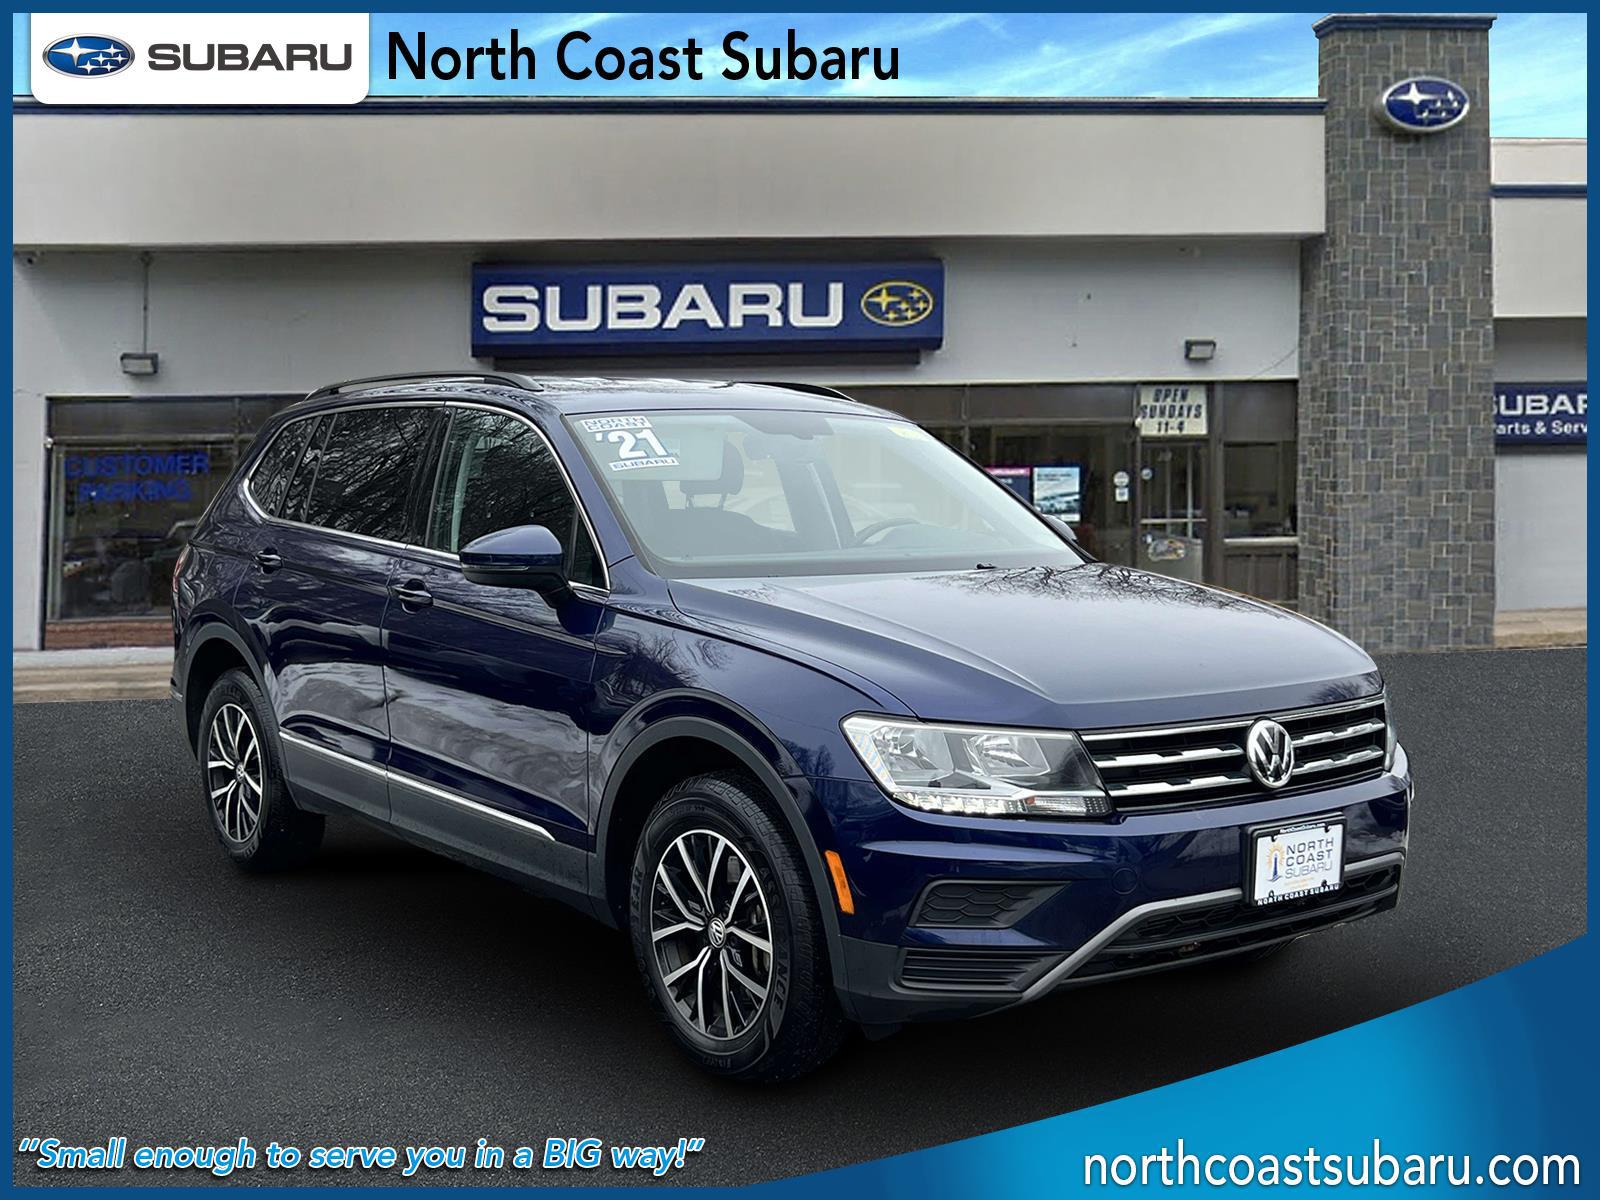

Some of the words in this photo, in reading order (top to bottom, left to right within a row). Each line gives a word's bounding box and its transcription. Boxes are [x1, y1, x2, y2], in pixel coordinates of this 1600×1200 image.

[482, 282, 844, 332] SUBARU
[1153, 388, 1189, 403] OPEN
[1493, 394, 1587, 416] UBA
[584, 416, 646, 427] NORTH
[1140, 404, 1202, 419] SUNDAYS
[1157, 421, 1185, 433] 11-4
[1534, 421, 1547, 435] &
[595, 428, 668, 460] '21
[65, 451, 209, 477] CUSTOMER
[612, 458, 677, 470] SUBARU
[78, 479, 191, 503] PARKING
[1286, 837, 1335, 856] NORTH
[1286, 848, 1333, 868] COAST
[1285, 860, 1333, 880] SUBARU
[1257, 893, 1283, 906] NORTH
[1284, 888, 1309, 900] COAST
[1309, 883, 1340, 896] SUBARU
